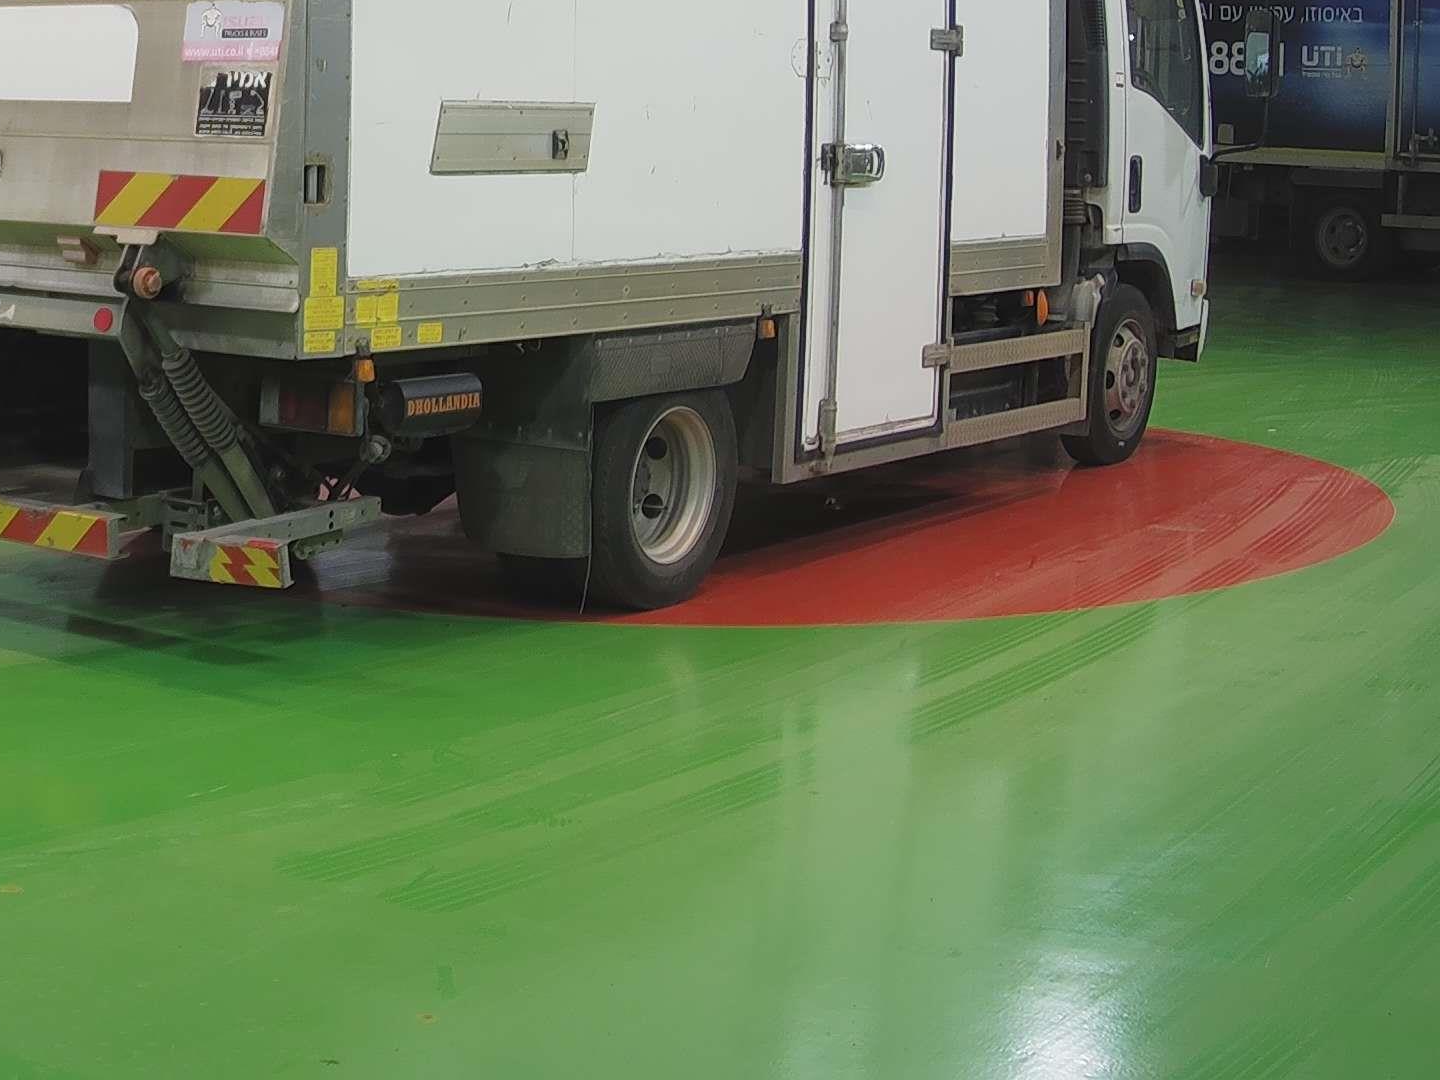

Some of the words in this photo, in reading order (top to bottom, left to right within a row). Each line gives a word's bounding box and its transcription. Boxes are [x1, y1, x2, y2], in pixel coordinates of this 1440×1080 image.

[1219, 5, 1242, 22] עם
[1300, 5, 1363, 24] באיסוזו,
[407, 392, 481, 417] DHOLLANDIA
